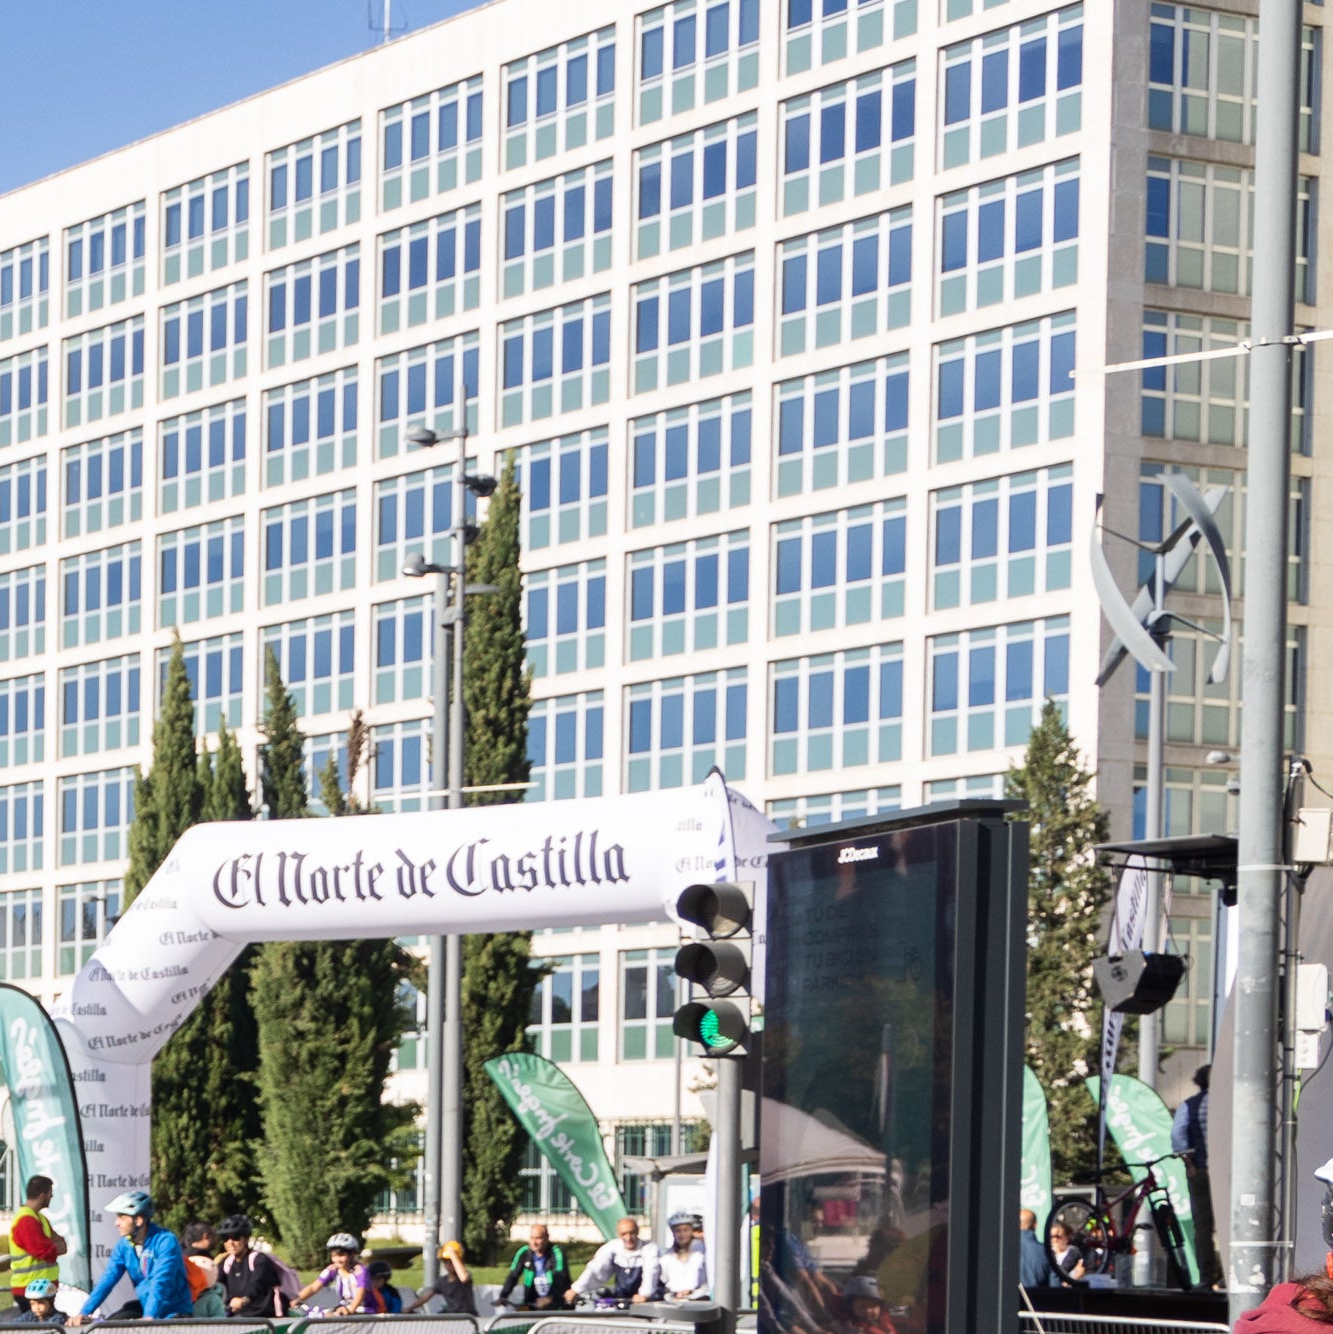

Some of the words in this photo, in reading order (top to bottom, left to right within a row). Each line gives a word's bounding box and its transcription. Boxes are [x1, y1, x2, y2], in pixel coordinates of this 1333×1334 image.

[213, 852, 266, 908] El
[278, 850, 383, 907] Norte
[396, 848, 436, 900] de
[446, 829, 631, 897] Castilla
[99, 1103, 129, 1118] Norte
[97, 1173, 127, 1188] Norte
